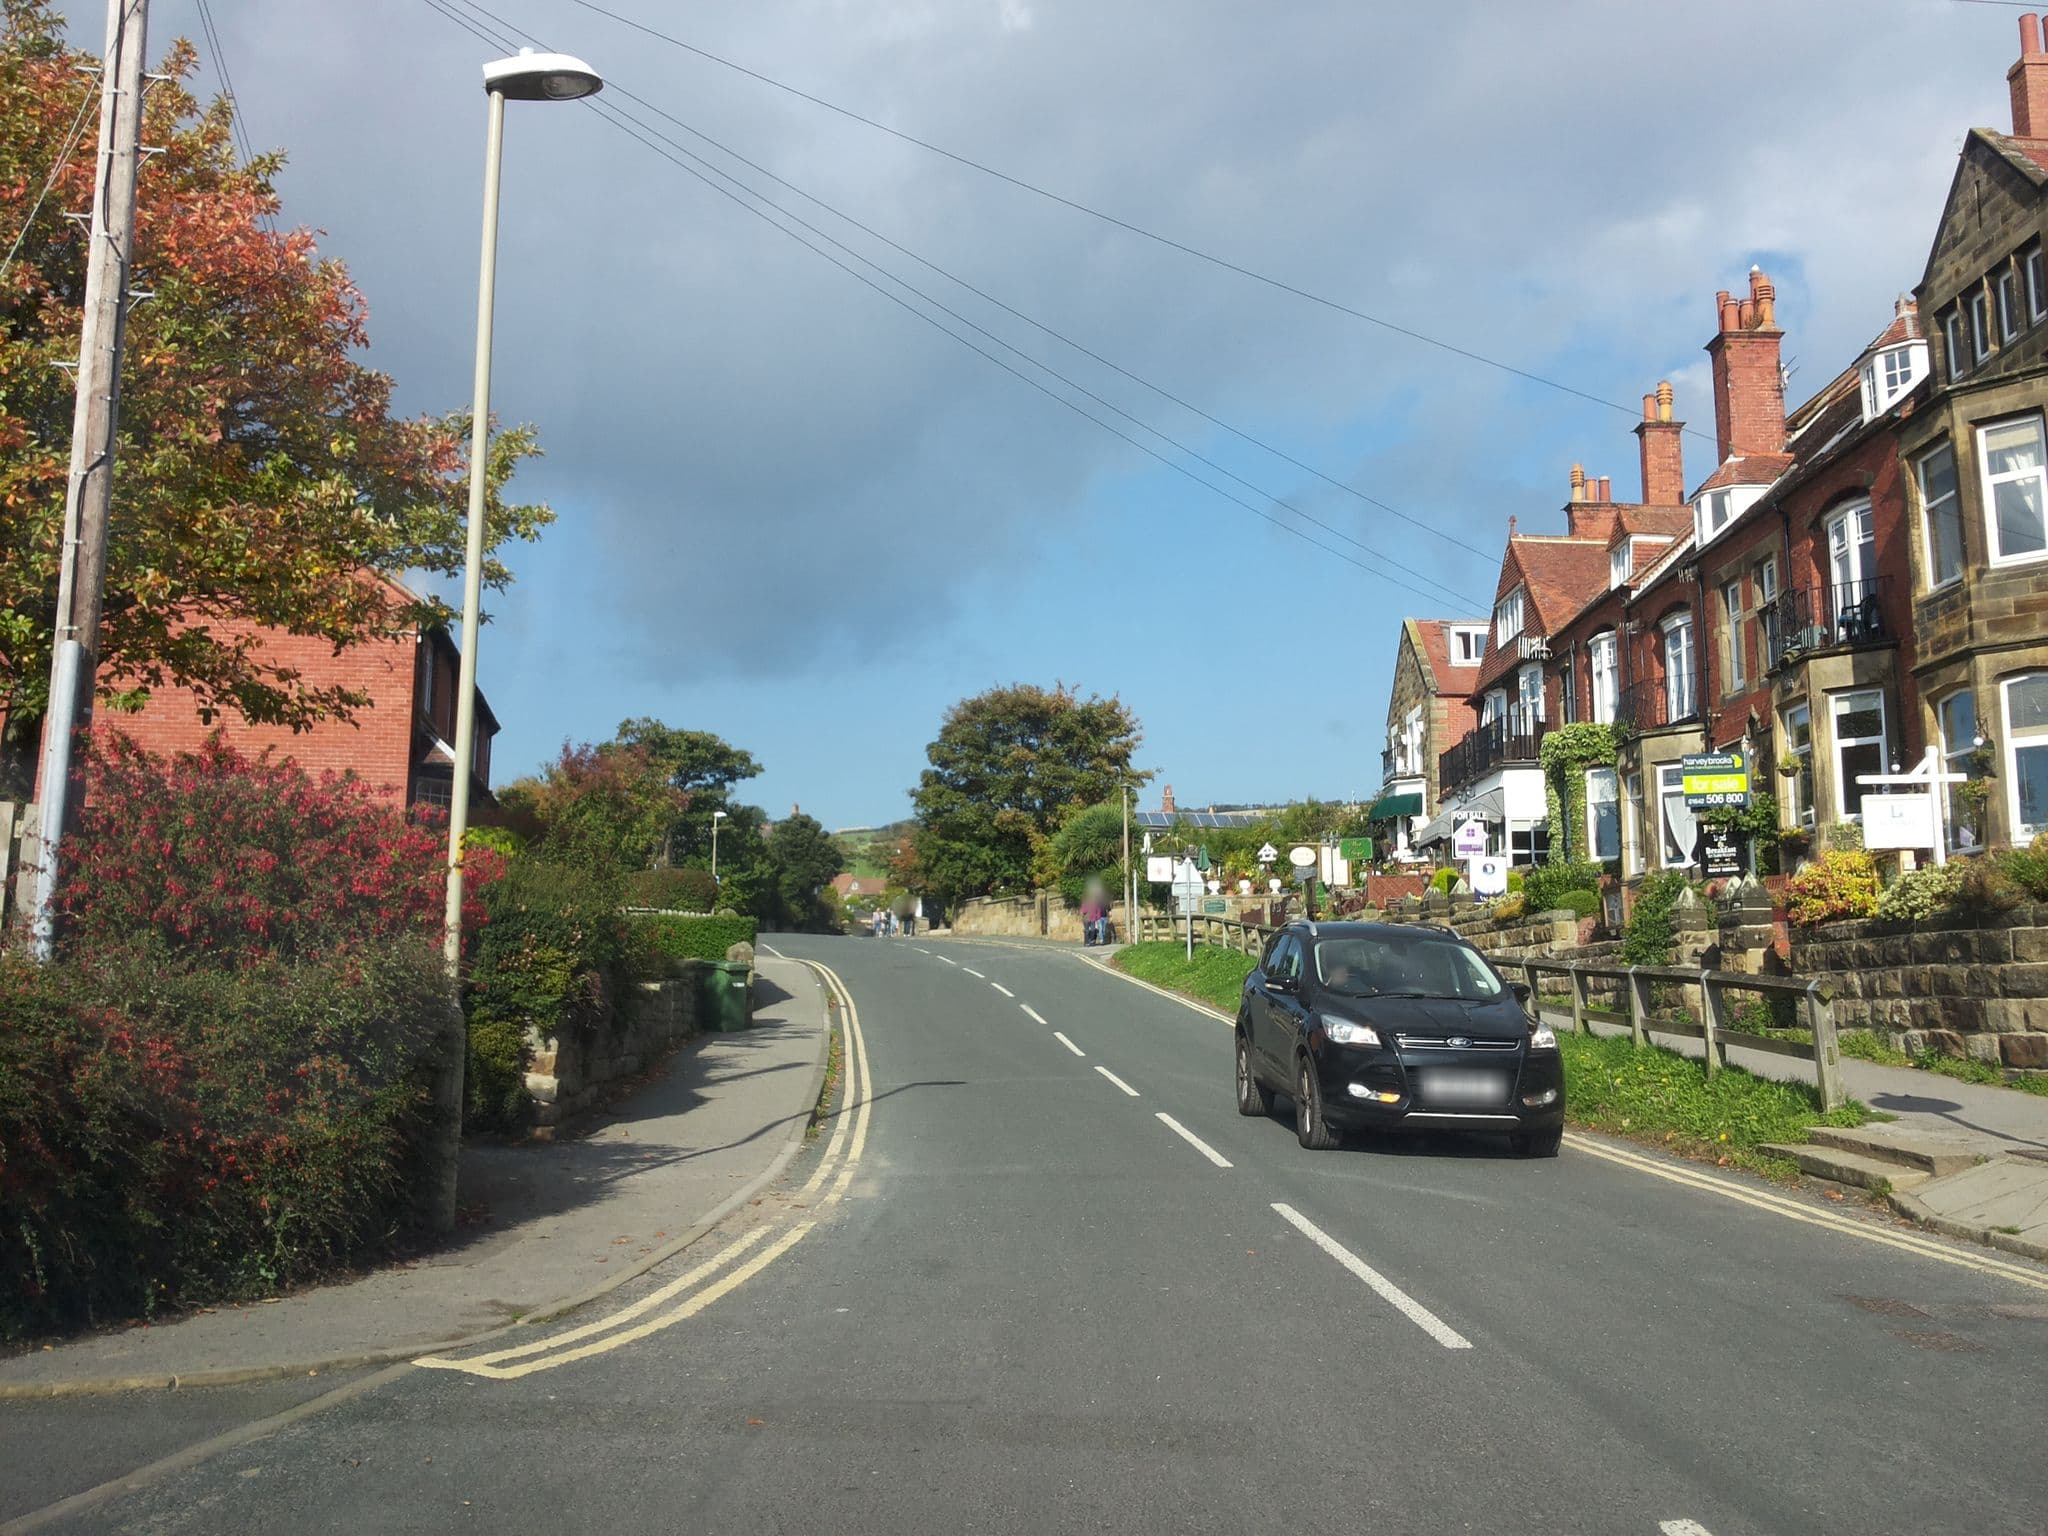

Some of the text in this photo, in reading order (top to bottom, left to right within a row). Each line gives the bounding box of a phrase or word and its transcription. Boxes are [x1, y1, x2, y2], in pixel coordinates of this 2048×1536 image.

[1706, 794, 1724, 804] 506
[1726, 793, 1744, 803] 800
[1452, 811, 1488, 820] FOR SALE
